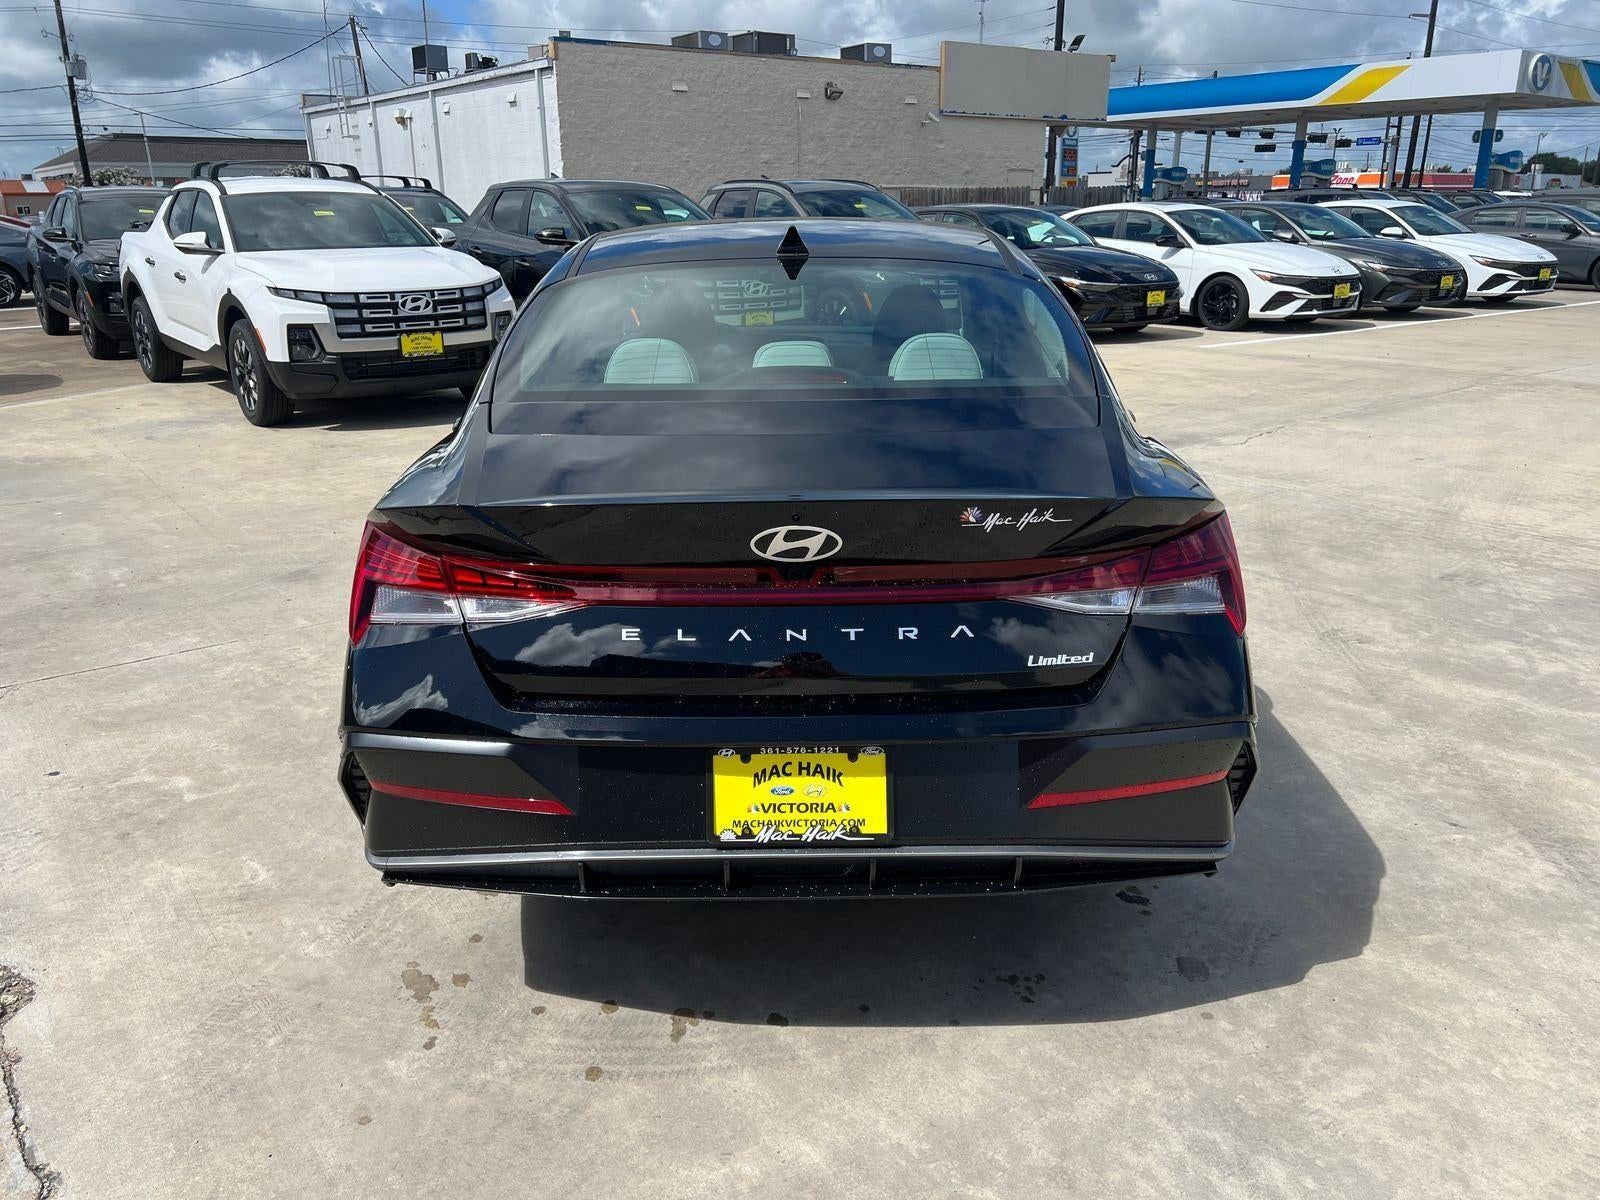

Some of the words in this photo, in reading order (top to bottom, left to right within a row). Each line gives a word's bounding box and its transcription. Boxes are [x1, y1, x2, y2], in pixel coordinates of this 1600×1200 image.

[1331, 175, 1355, 184] Zone
[981, 512, 1017, 533] Mac
[1016, 507, 1060, 531] Haik
[620, 624, 975, 642] ELANTRA
[1027, 651, 1094, 667] Limited
[760, 746, 840, 755] 361-576-1221
[753, 761, 793, 788] MAC
[797, 761, 844, 788] HAIK
[772, 785, 793, 796] Ford
[760, 802, 837, 814] VICTORIA
[751, 824, 801, 844] Mac
[800, 823, 858, 843] Haik
